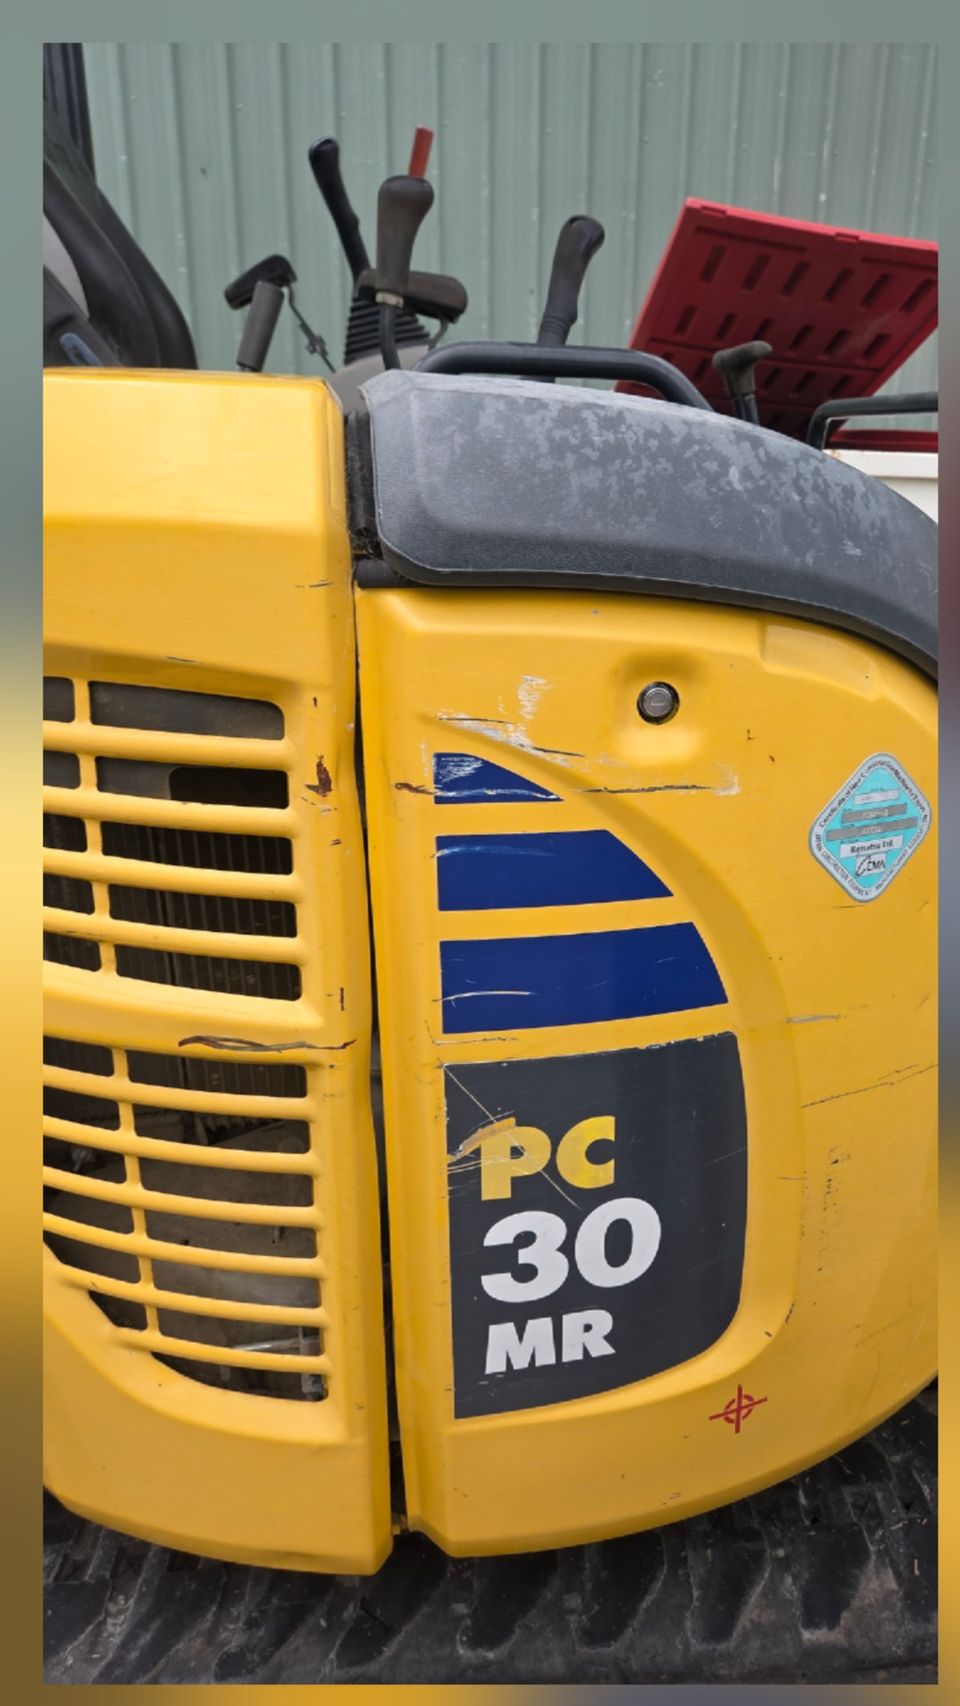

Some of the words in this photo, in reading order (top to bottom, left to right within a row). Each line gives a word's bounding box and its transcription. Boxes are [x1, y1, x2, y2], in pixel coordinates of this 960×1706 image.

[480, 1115, 616, 1201] PC
[481, 1197, 662, 1303] 30
[485, 1309, 616, 1374] MR
